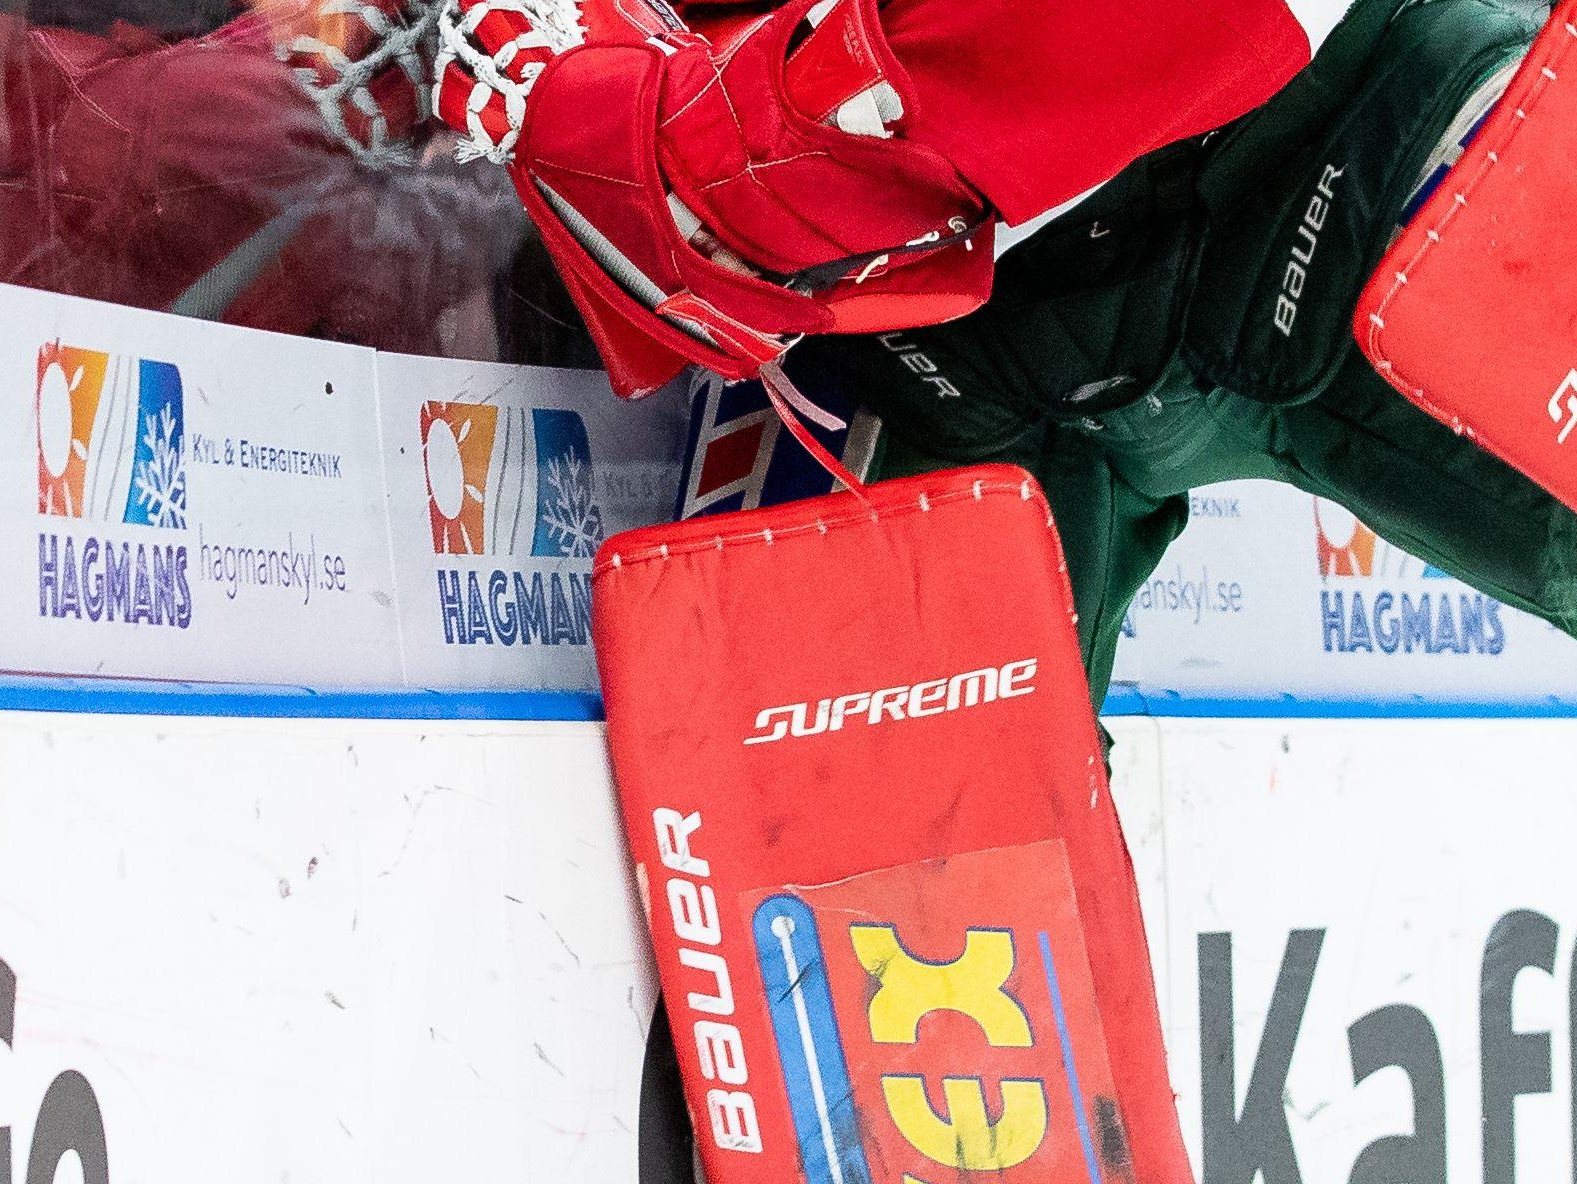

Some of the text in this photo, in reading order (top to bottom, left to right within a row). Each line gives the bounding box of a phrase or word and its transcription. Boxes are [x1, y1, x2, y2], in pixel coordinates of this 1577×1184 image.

[876, 331, 961, 398] UER
[37, 530, 192, 630] HAGMANS
[197, 522, 348, 606] hagmanskyl.se
[437, 569, 595, 647] HAGMAN
[1320, 589, 1507, 657] HAGMANS
[743, 657, 1039, 746] SUPREME
